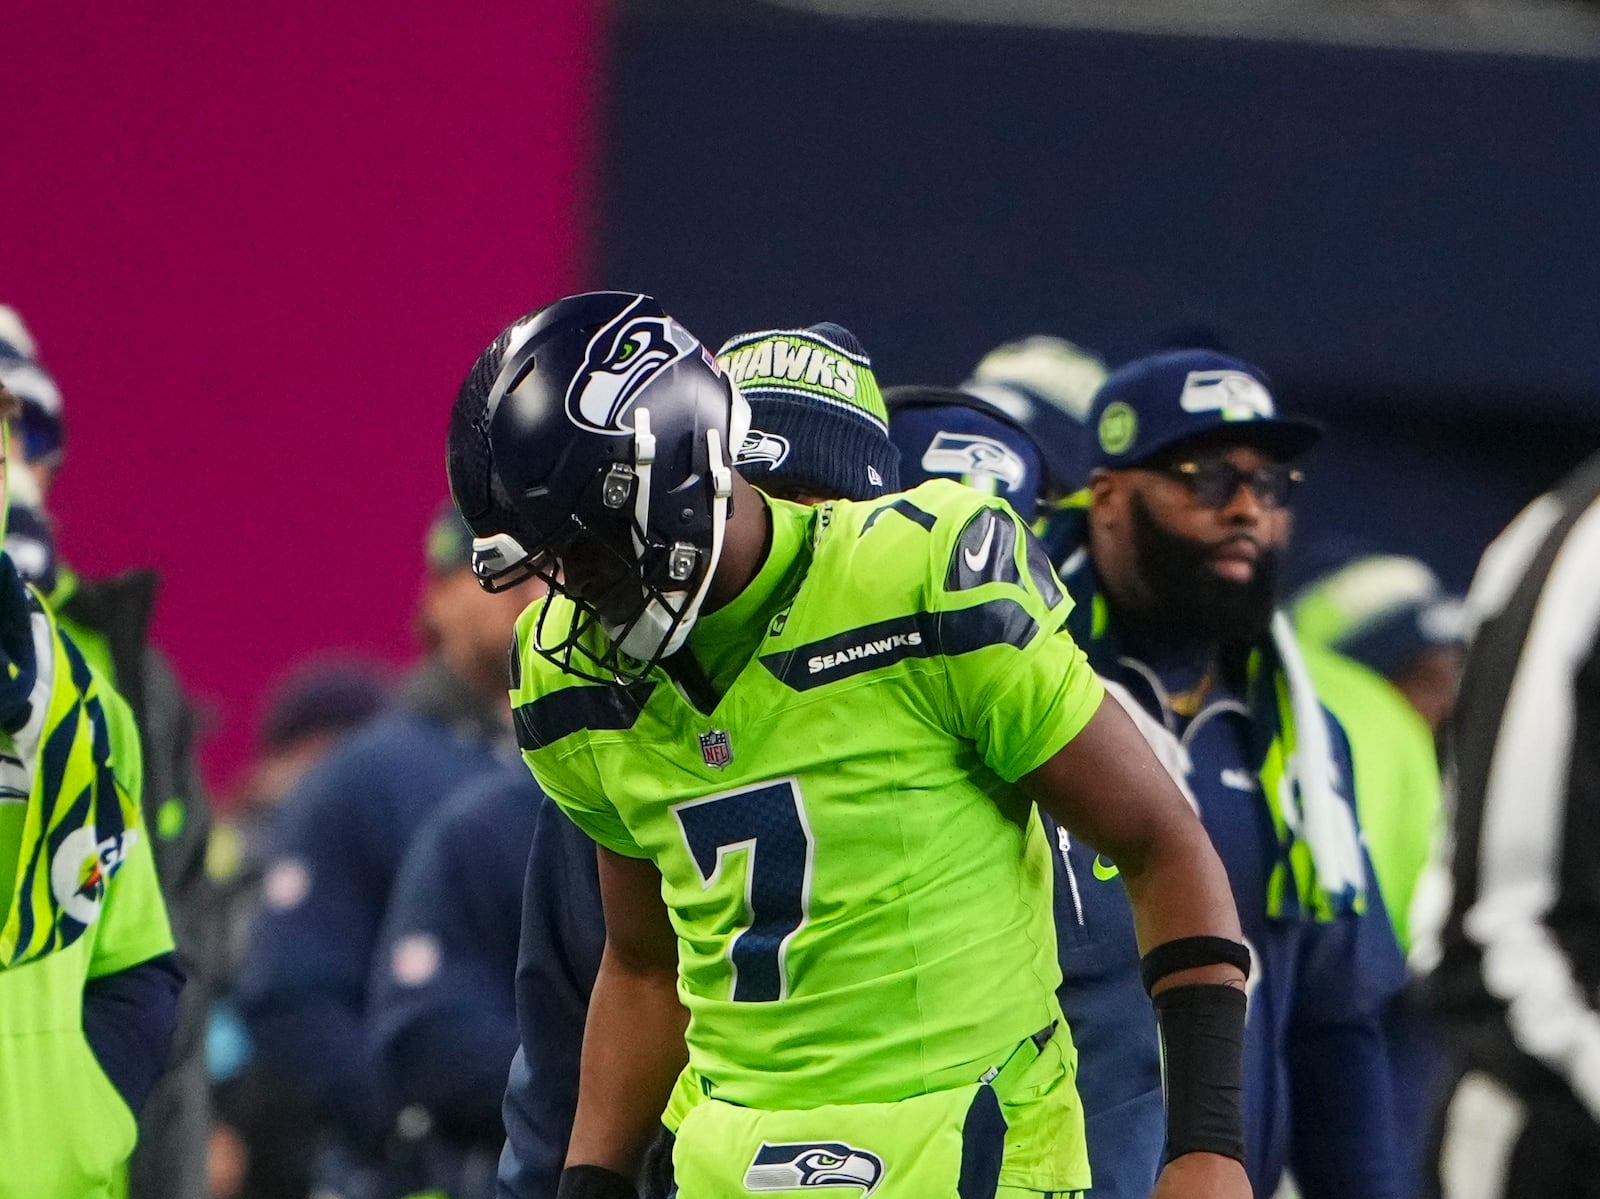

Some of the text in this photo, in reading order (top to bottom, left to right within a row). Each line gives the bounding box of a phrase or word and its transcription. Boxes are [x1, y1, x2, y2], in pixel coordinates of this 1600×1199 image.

[807, 631, 922, 674] SEAHAWKS
[704, 744, 728, 762] NFL
[670, 777, 814, 1002] 7
